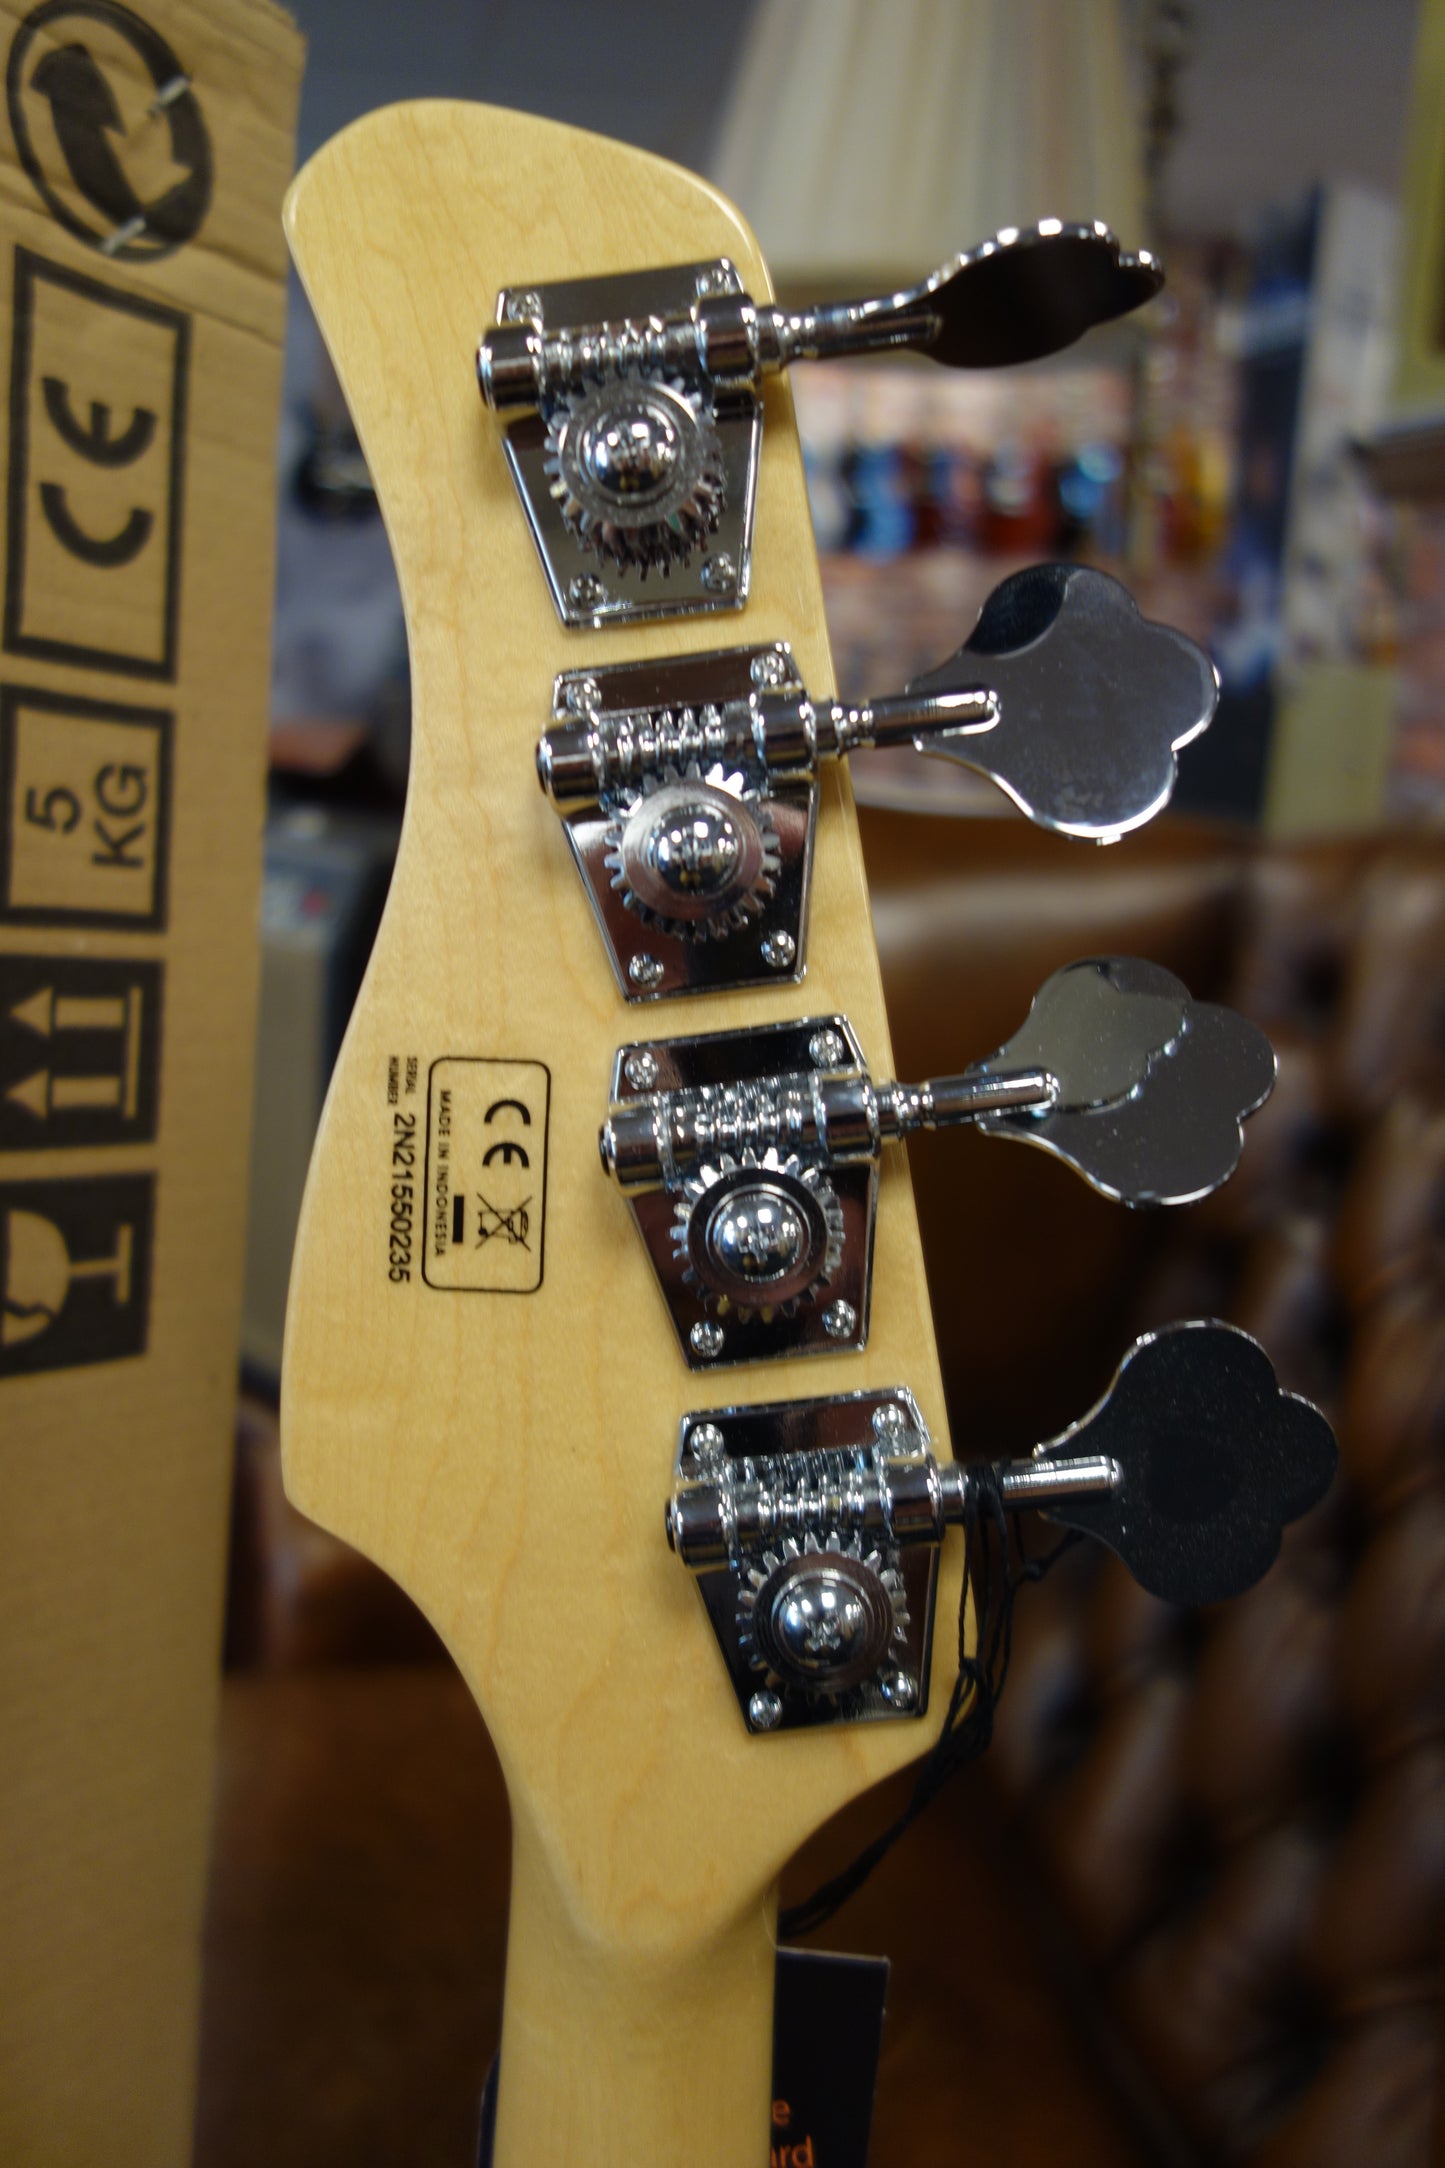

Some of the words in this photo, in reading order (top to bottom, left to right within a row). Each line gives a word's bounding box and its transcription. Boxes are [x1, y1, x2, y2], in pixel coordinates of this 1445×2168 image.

[40, 376, 157, 568] CE
[25, 786, 83, 835] 5
[92, 762, 148, 869] KG
[387, 1055, 399, 1105] NUMBER
[405, 1056, 417, 1094] SERIAL
[439, 1089, 451, 1136] MADE
[482, 1099, 531, 1169] CE
[438, 1142, 450, 1159] IN
[389, 1112, 416, 1283] 2N21550235
[435, 1164, 448, 1257] INDONESIA
